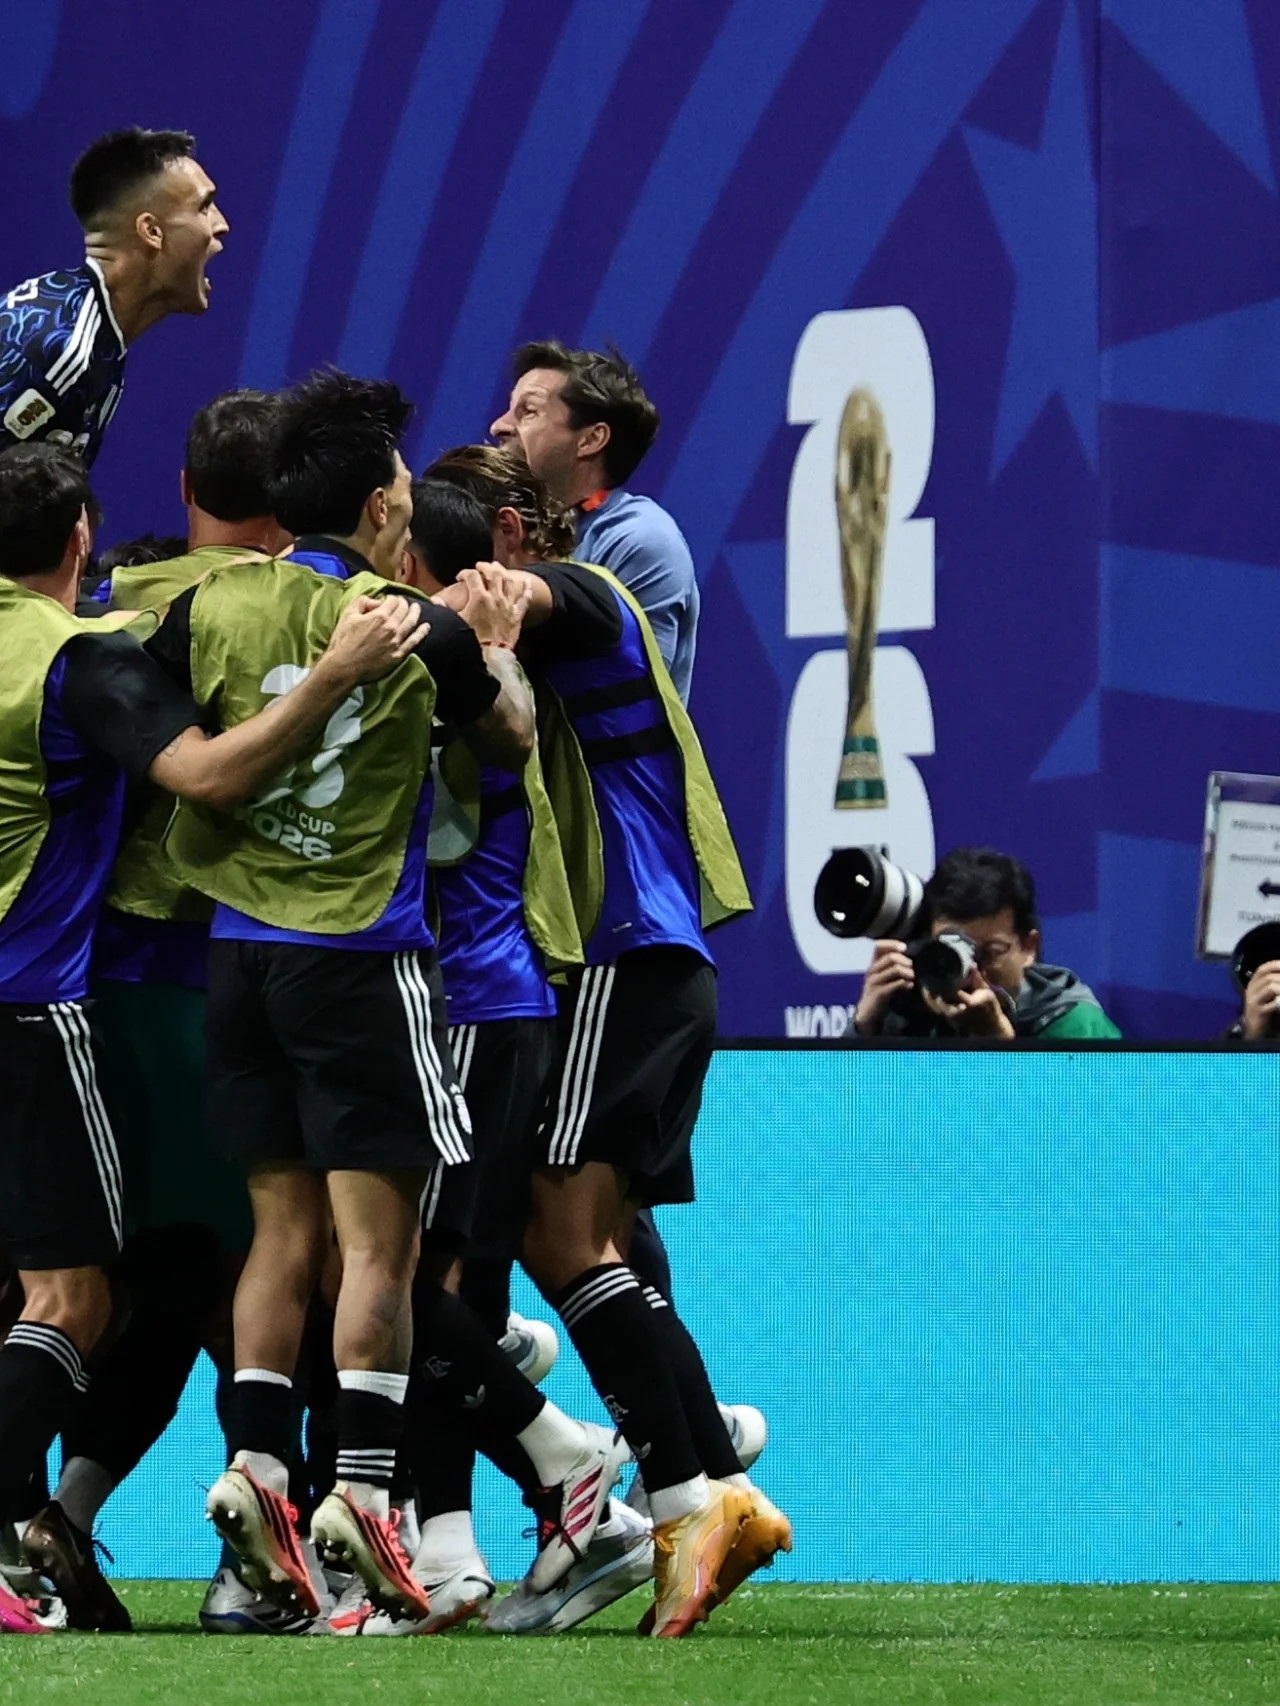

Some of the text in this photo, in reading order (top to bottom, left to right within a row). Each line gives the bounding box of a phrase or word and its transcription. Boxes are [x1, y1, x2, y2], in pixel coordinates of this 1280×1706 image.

[235, 808, 332, 862] 026
[299, 812, 336, 836] CUP
[784, 1004, 856, 1038] WOR
